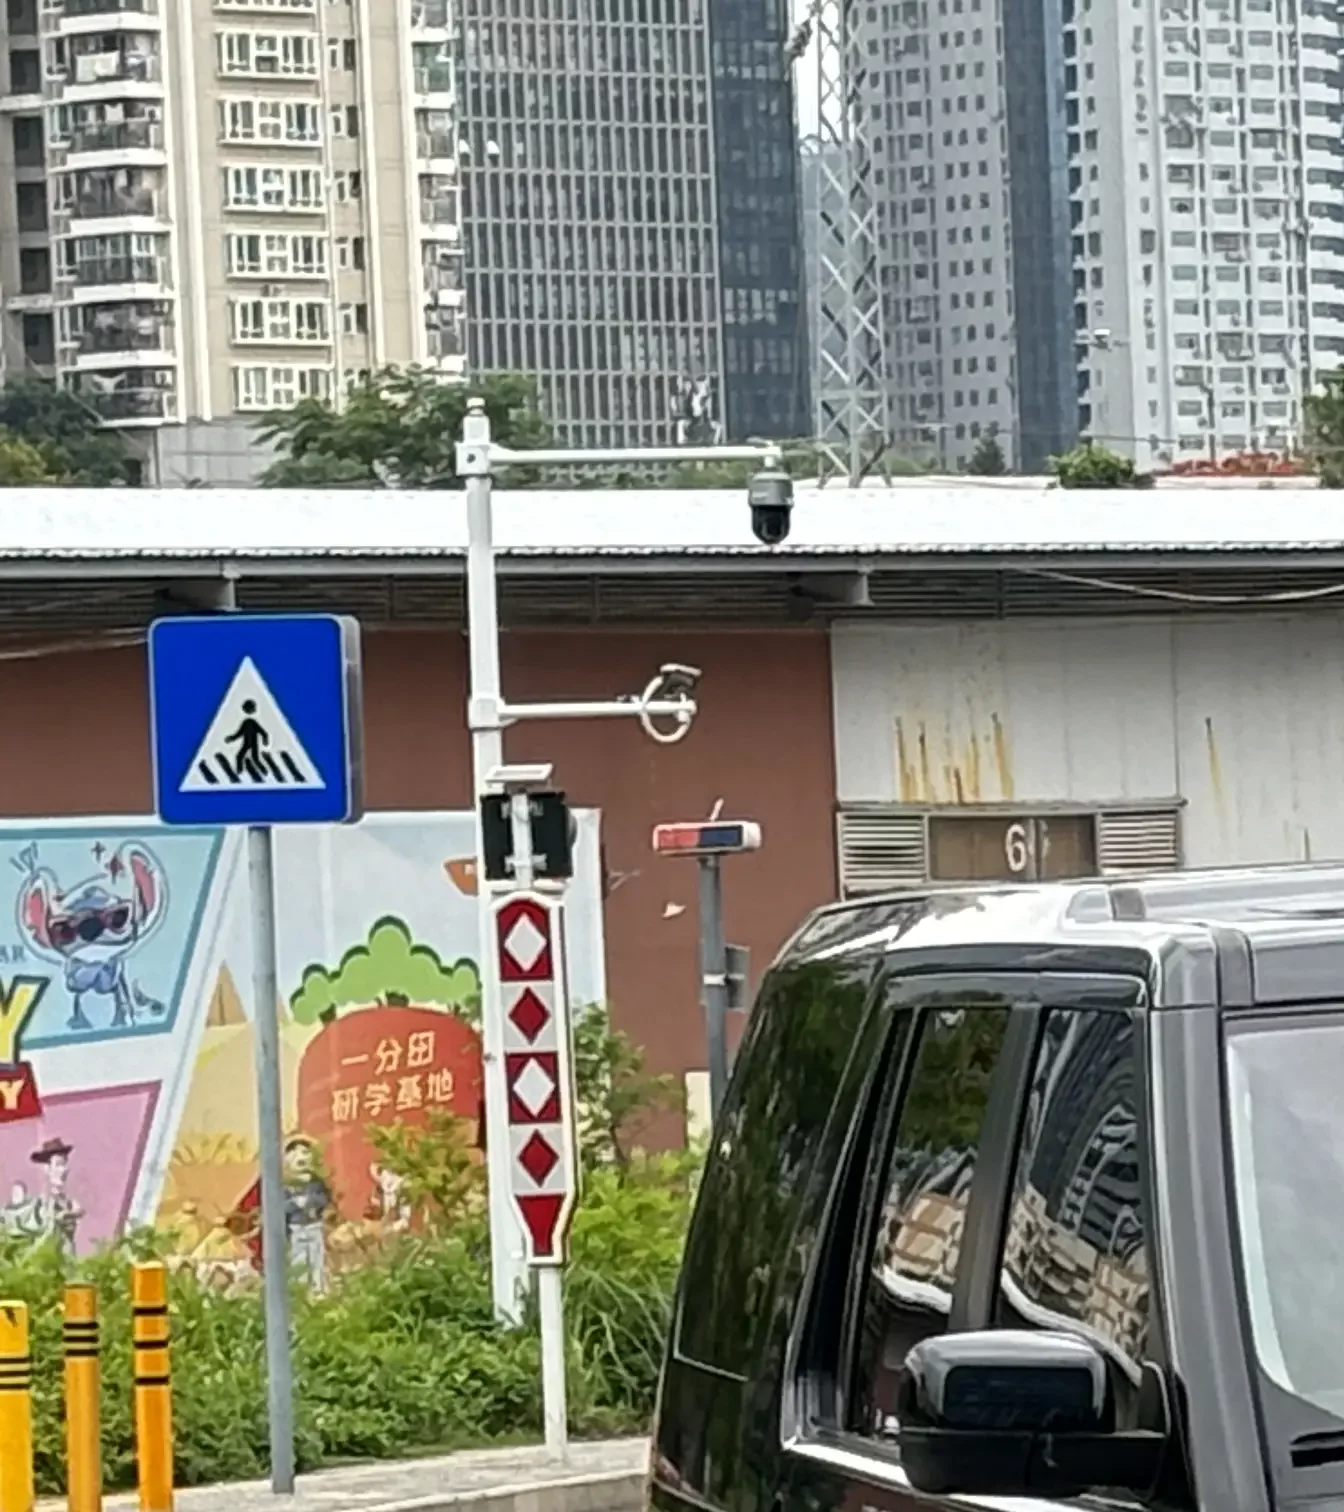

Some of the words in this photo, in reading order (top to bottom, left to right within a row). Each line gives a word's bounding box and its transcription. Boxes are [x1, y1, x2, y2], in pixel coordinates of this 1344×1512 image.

[1005, 823, 1027, 872] 6
[341, 1030, 435, 1076] 一分田
[332, 1067, 454, 1121] 研学基地
